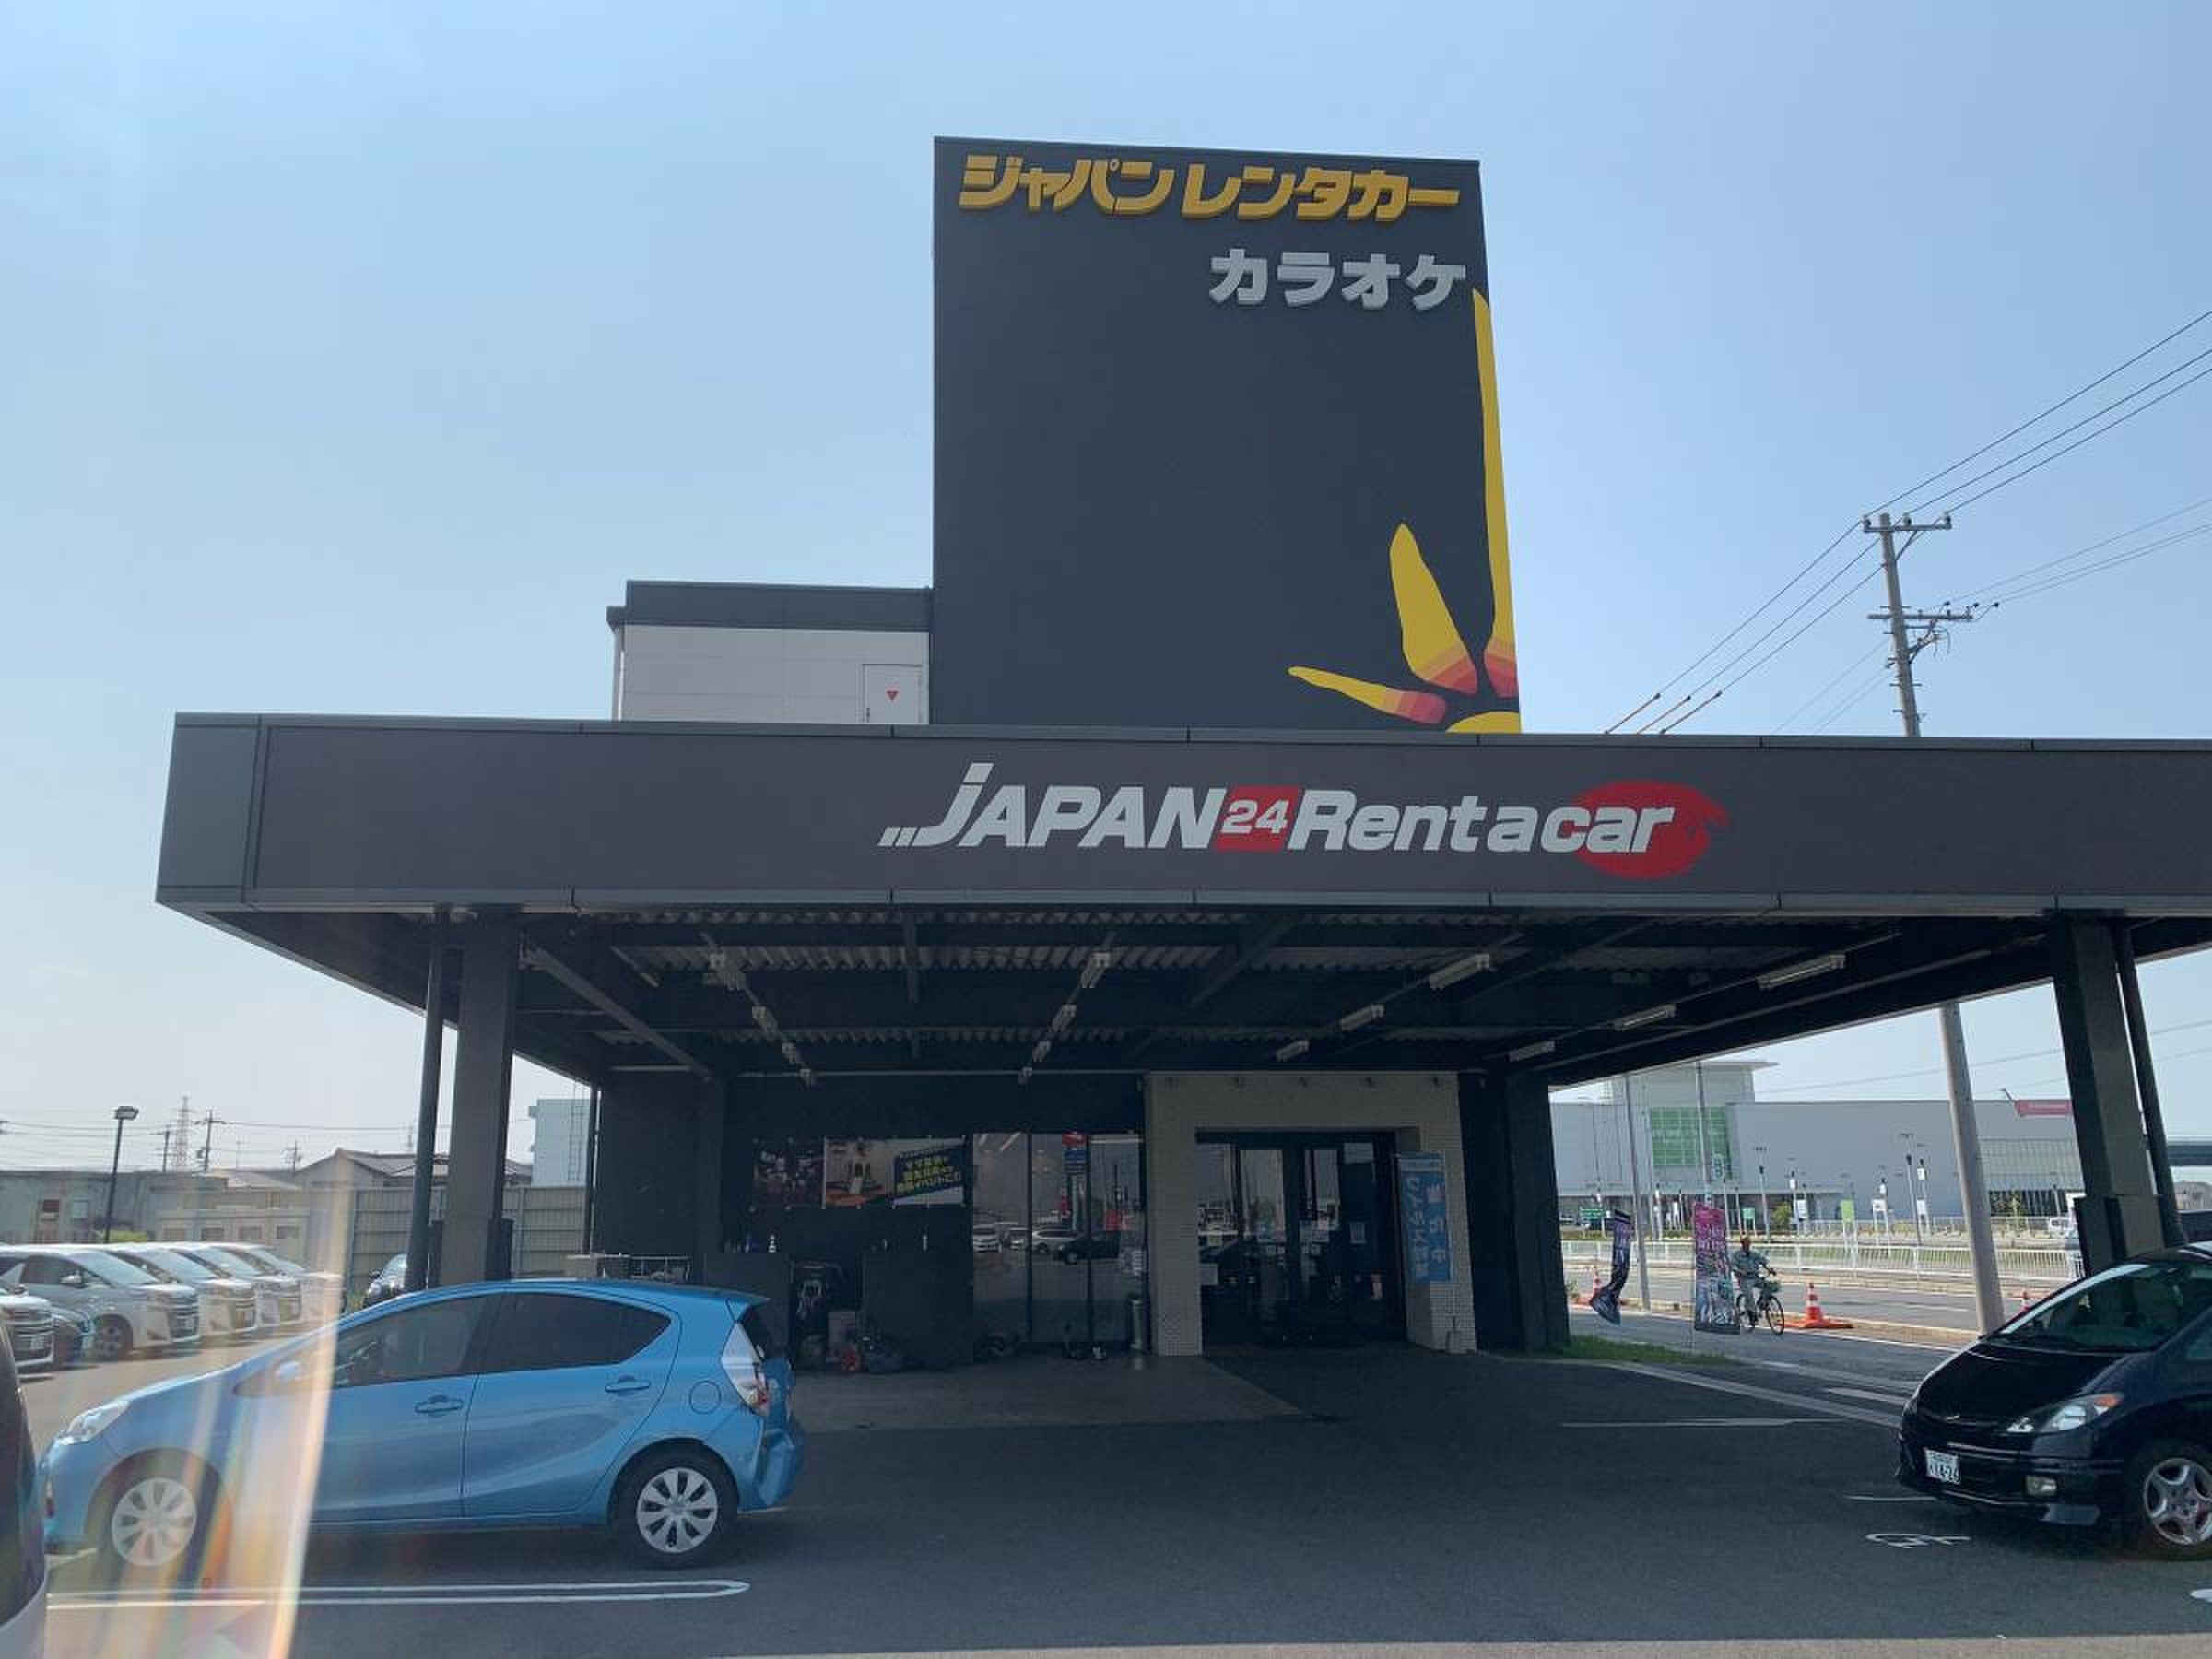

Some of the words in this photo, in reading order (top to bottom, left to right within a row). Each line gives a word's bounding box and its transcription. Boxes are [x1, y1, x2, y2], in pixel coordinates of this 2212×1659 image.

[1209, 248, 1466, 310] カラオケ
[1220, 799, 1288, 833] 24
[1288, 789, 1485, 853] Rent
[1540, 804, 1675, 853] car
